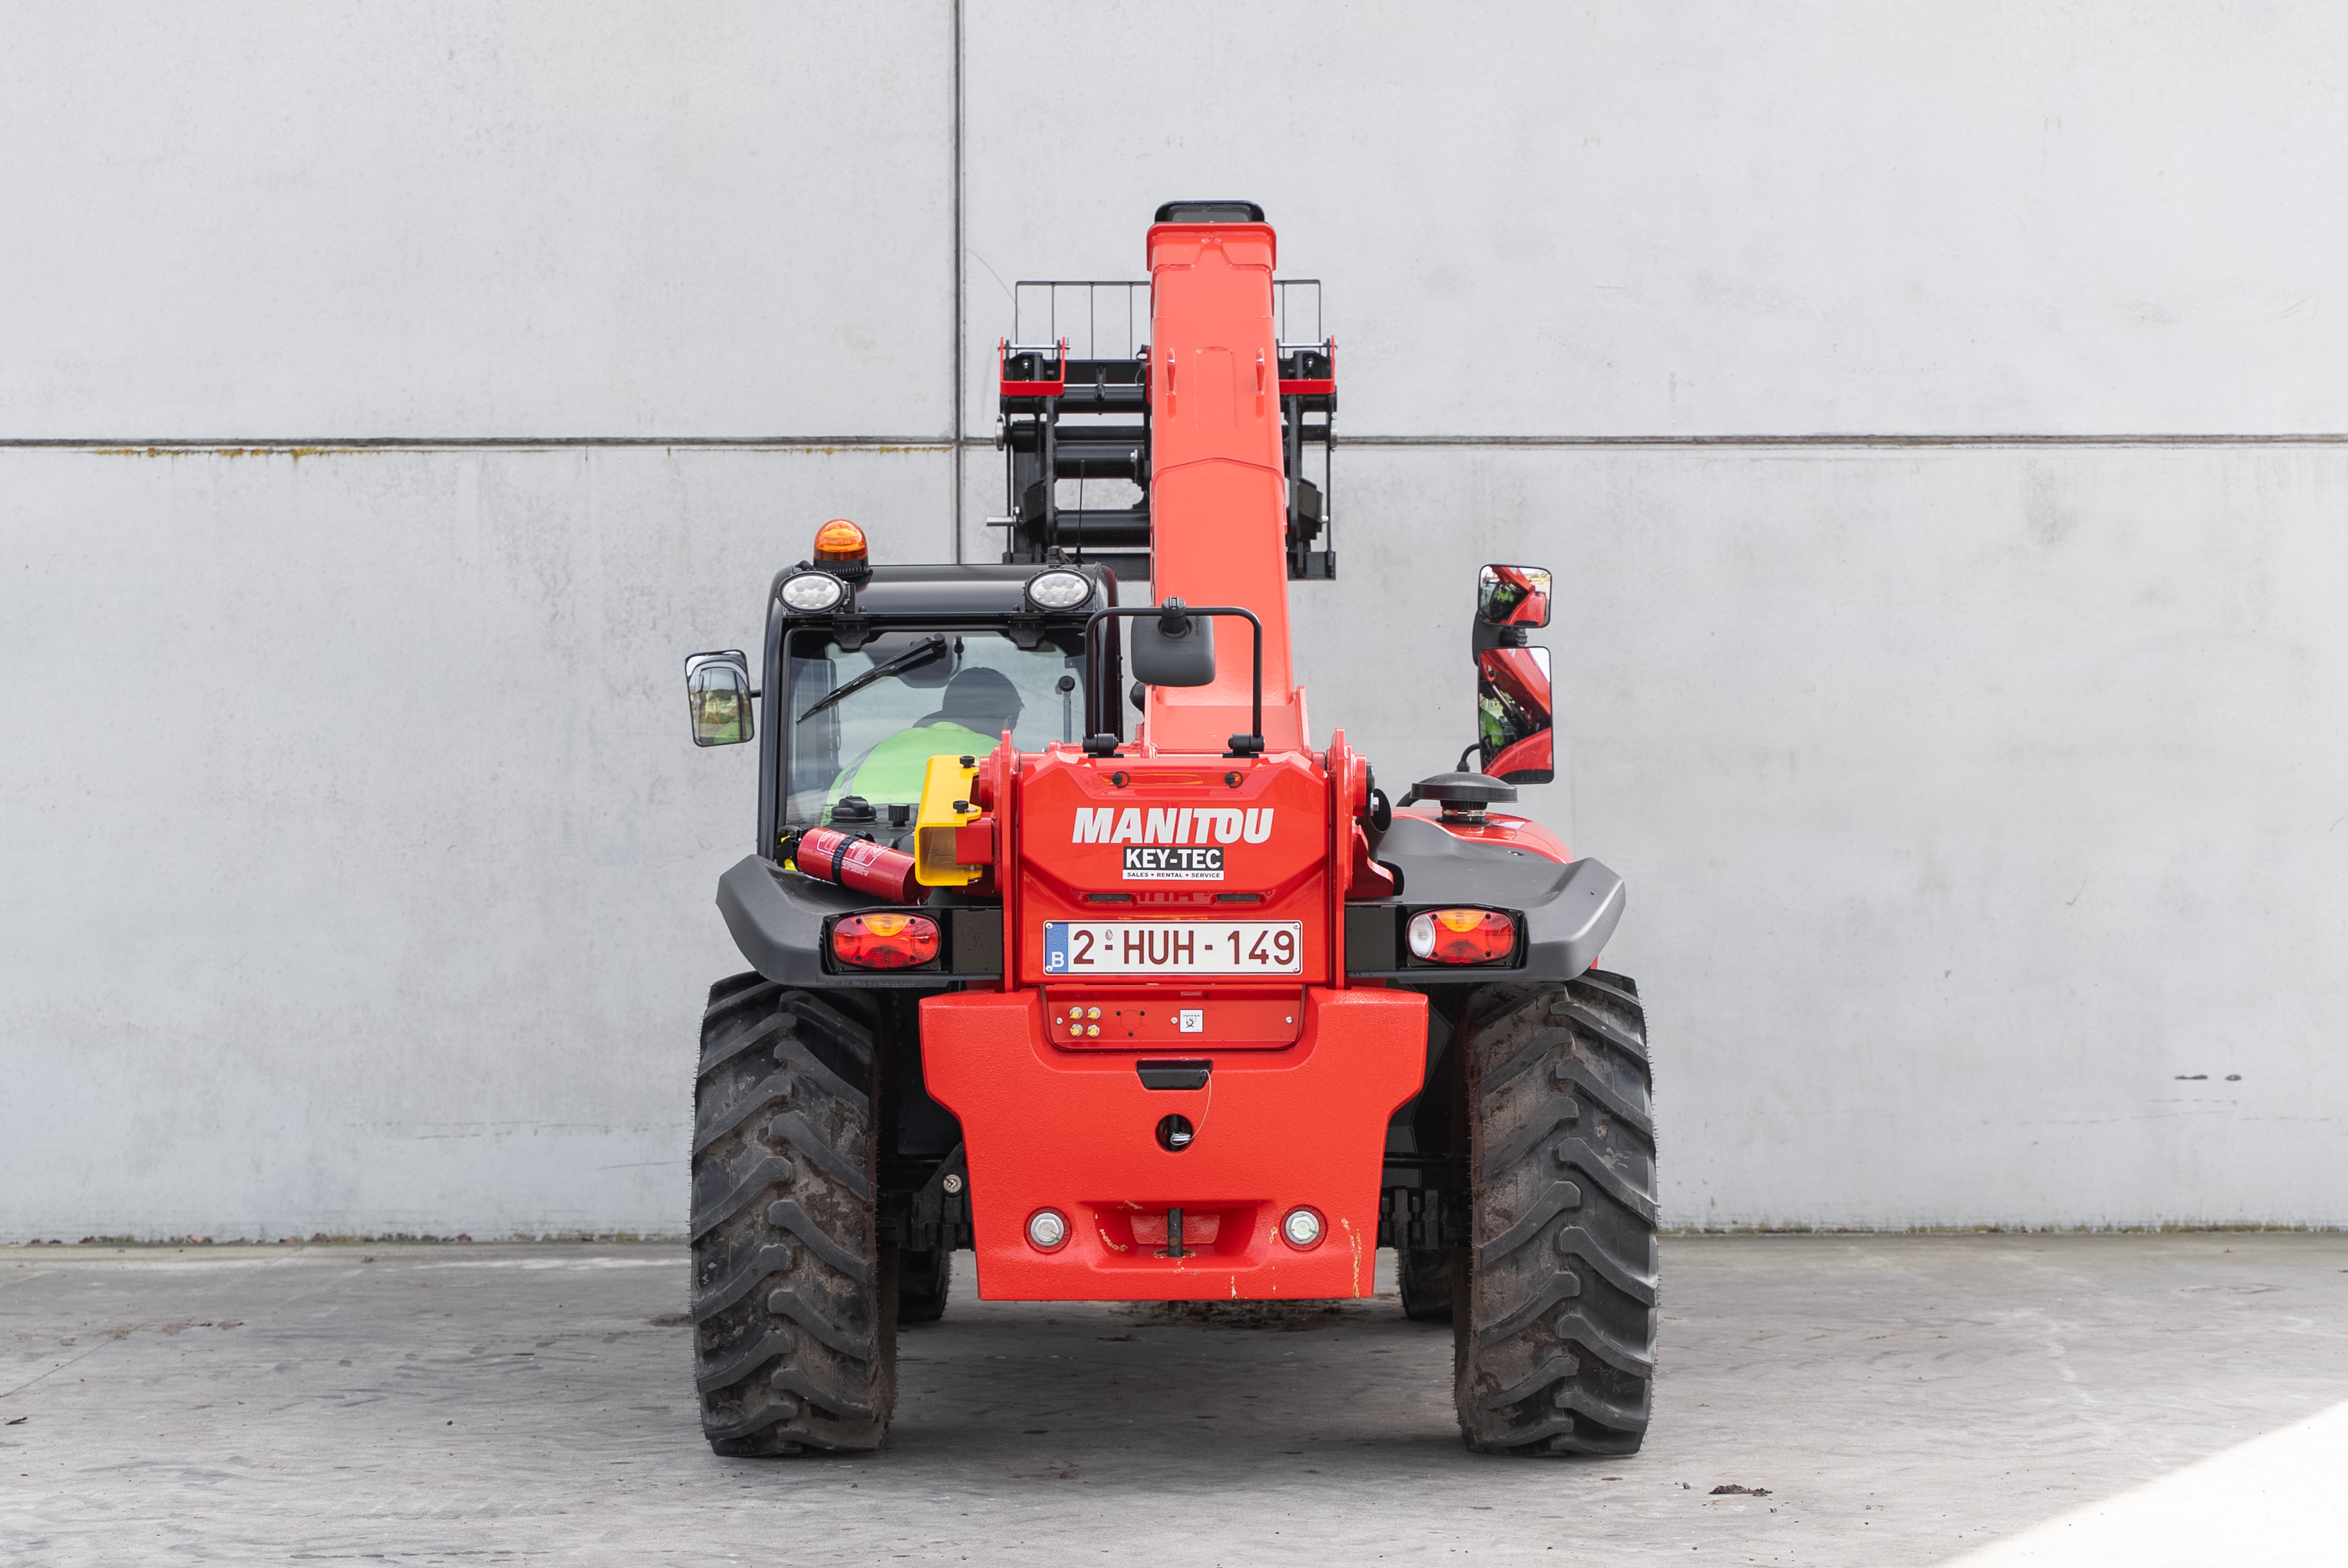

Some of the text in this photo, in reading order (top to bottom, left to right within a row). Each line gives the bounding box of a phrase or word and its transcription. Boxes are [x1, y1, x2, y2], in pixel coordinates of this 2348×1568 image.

[1072, 807, 1274, 844] MANITOU
[1126, 849, 1221, 869] KEY-TEC
[1051, 951, 1065, 968] B
